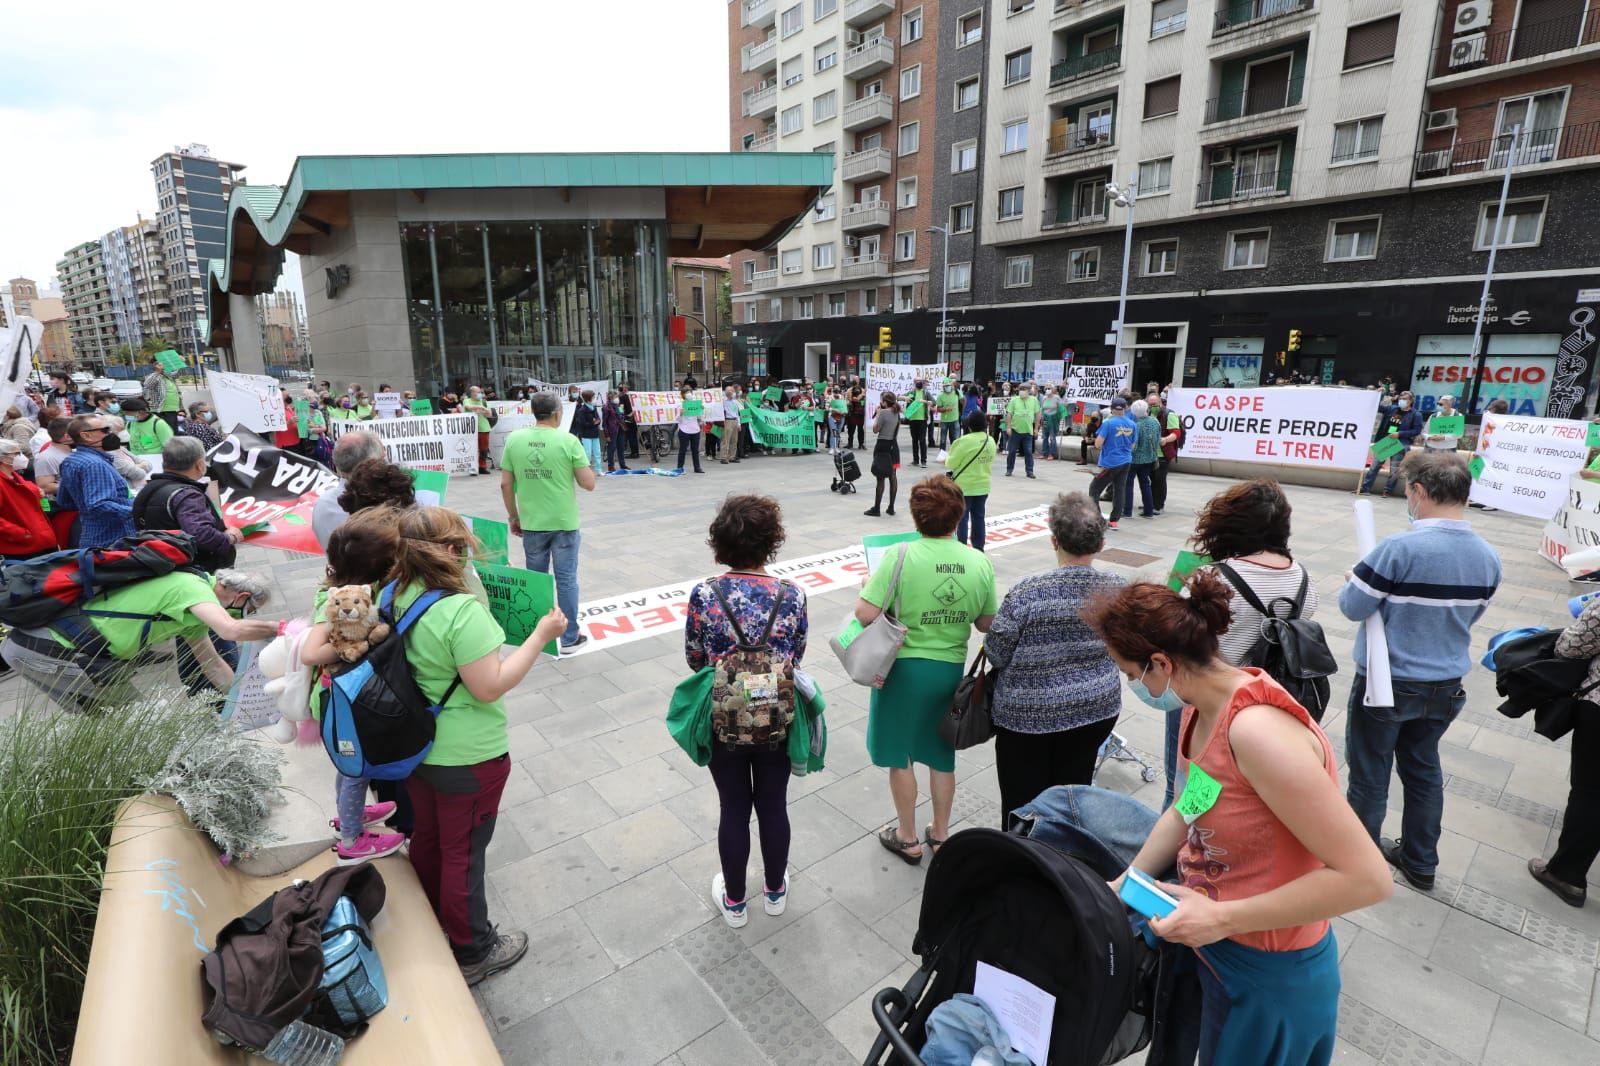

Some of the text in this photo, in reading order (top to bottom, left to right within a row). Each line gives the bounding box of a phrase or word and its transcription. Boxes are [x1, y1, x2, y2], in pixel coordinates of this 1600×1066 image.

[1078, 378, 1120, 389] QUEREMOS
[1194, 394, 1265, 412] CASPE
[433, 417, 443, 435] ES
[446, 414, 476, 434] FUTURO
[1203, 415, 1272, 434] QUIERE
[1278, 418, 1358, 440] PERDER
[1503, 421, 1587, 441] POR UN TREN
[396, 441, 444, 462] TERRITORIO
[1255, 439, 1334, 461] EL TREN
[1495, 440, 1586, 460] ACCESIBLE INTERMODAL
[1515, 466, 1562, 480] ECOLÓGICO
[1512, 485, 1547, 499] SEGURO
[658, 589, 687, 600] en
